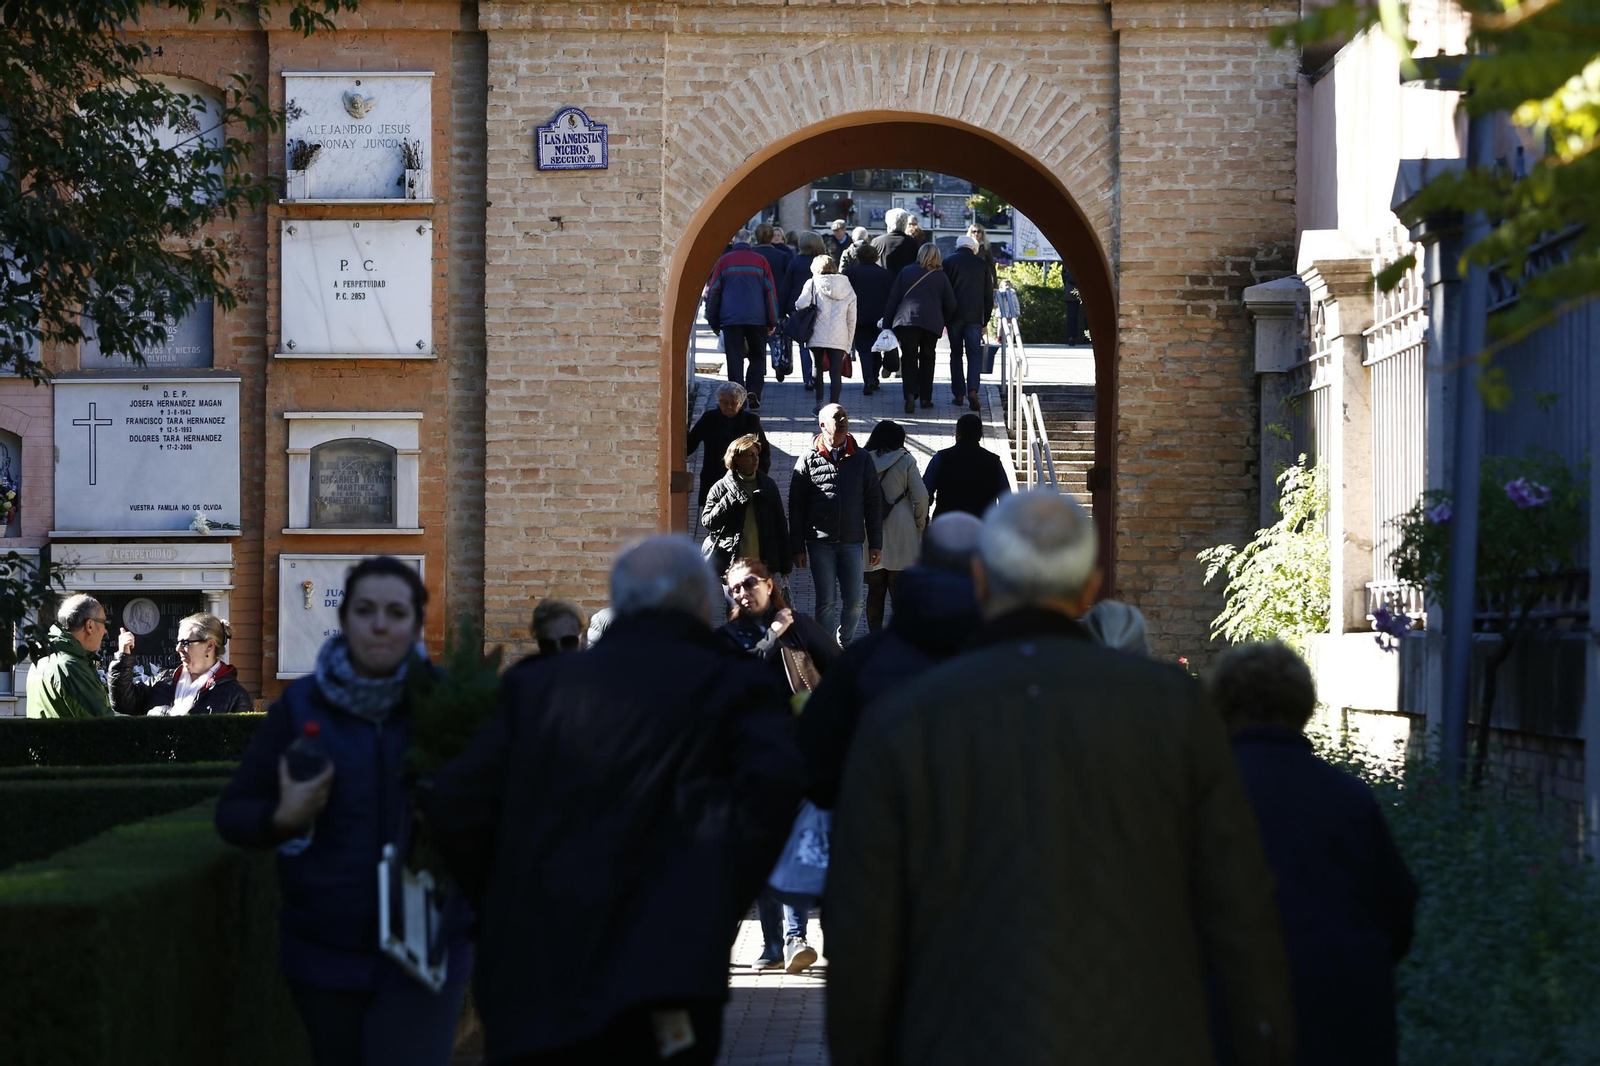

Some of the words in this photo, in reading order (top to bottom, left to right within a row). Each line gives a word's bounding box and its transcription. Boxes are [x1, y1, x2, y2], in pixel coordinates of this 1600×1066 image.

[306, 124, 372, 134] ALEJANDRO
[378, 124, 410, 134] JESUS
[544, 134, 560, 144] LAS
[562, 133, 602, 144] ANGUSTIAS
[363, 140, 398, 148] JUNCO
[555, 144, 589, 155] NICHOS
[587, 155, 595, 163] 20
[340, 260, 348, 271] P.
[363, 260, 377, 271] C.
[320, 497, 361, 505] ARMENCITA
[120, 549, 172, 559] PERPETUIDAD
